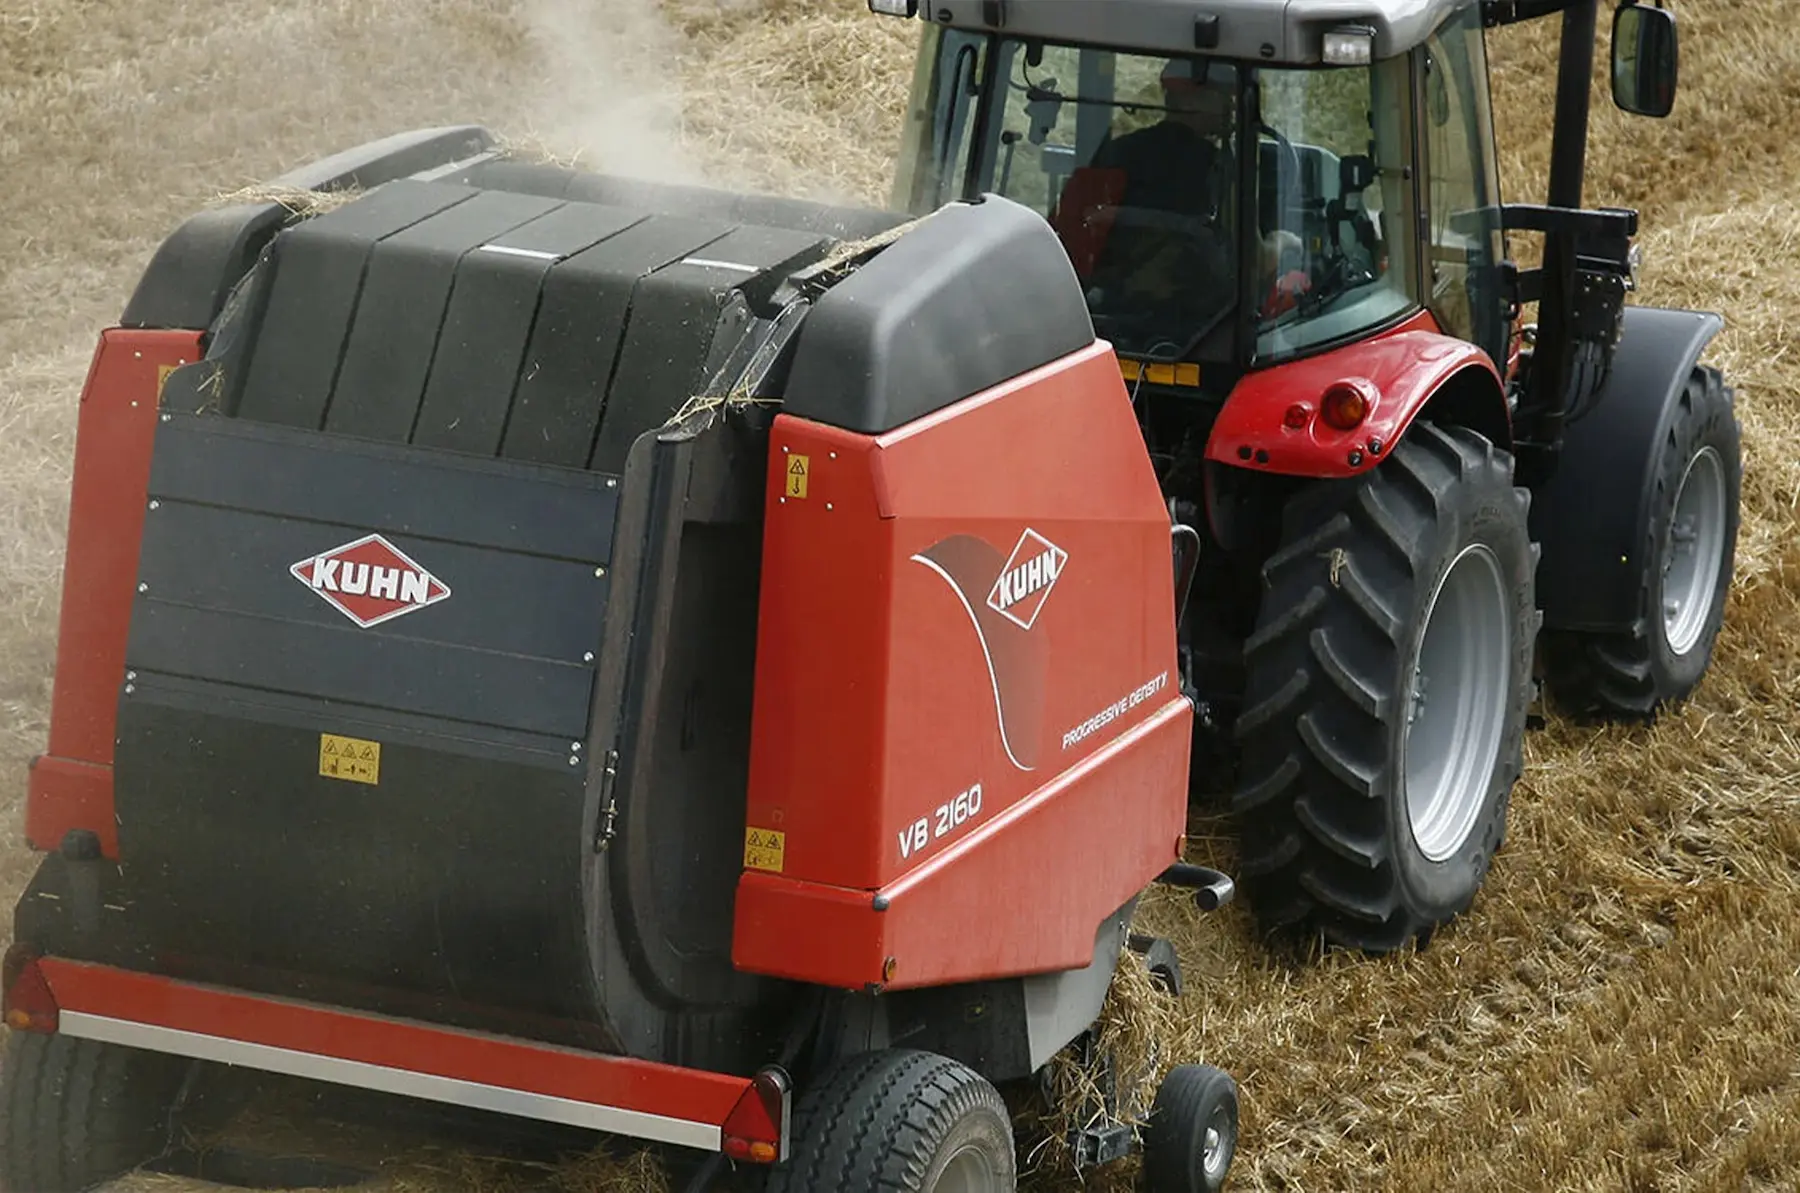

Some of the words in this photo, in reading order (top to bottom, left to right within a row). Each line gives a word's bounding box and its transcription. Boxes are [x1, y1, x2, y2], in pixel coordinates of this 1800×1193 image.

[312, 557, 430, 604] KUHN
[999, 547, 1056, 610] KUHN
[1062, 697, 1128, 750] PROGRESSIVE
[1129, 671, 1168, 708] DENSITY
[898, 817, 929, 859] VB
[935, 783, 982, 838] 2160
